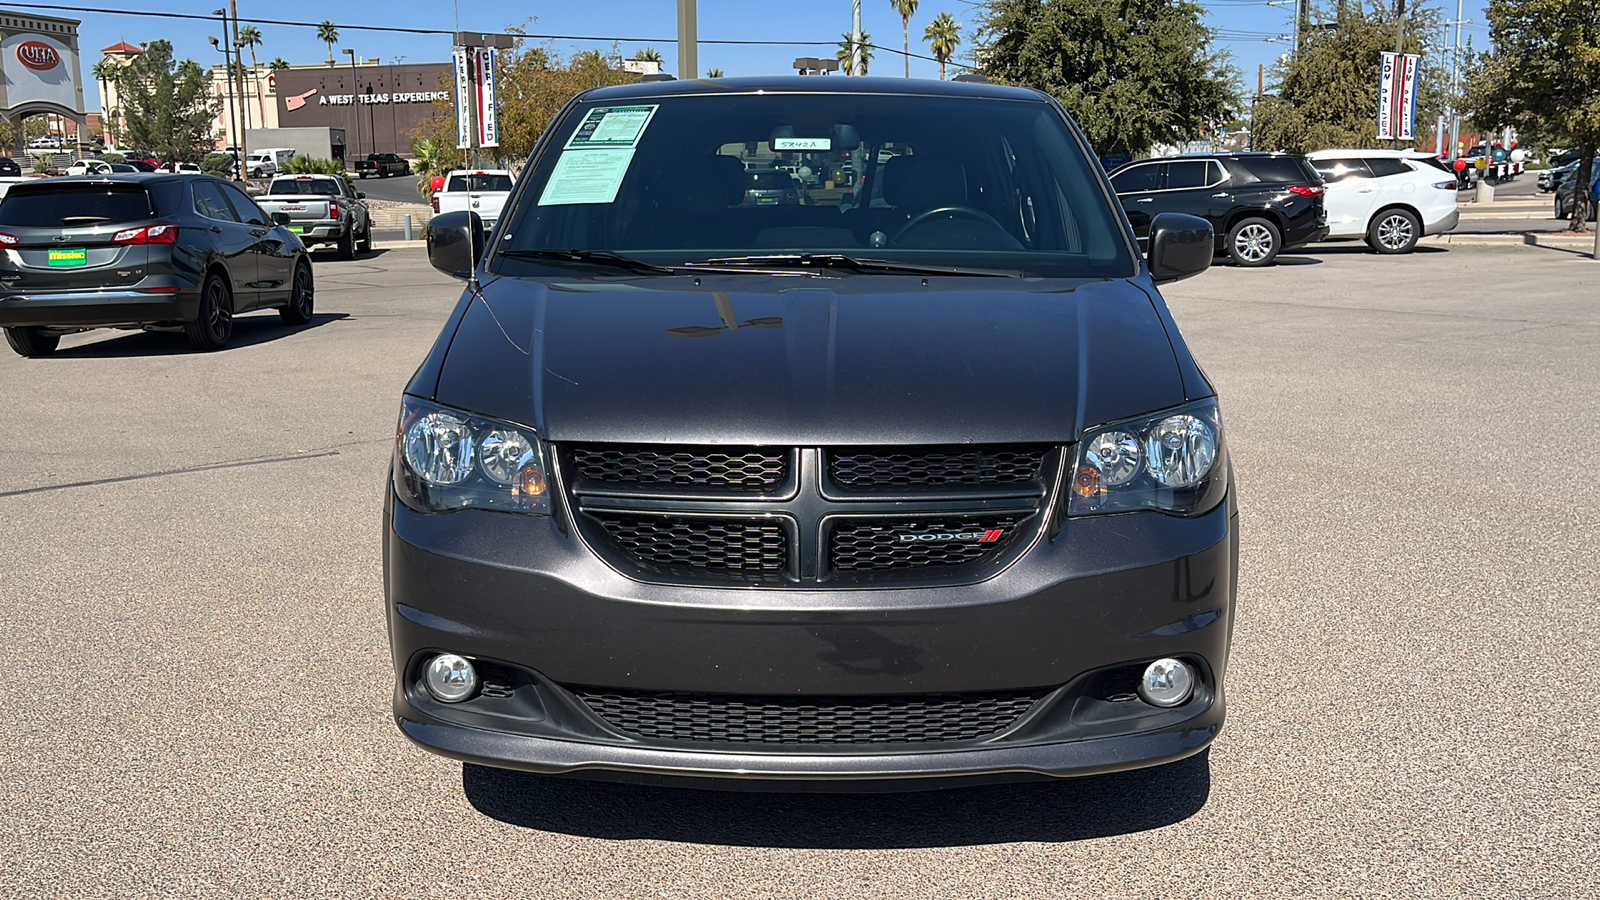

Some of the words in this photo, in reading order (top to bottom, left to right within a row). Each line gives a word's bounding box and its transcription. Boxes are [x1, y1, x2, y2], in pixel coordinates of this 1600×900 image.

[319, 95, 328, 104] A
[329, 94, 354, 104] WEST
[358, 93, 390, 104] TEXAS
[393, 91, 450, 104] EXPERIENCE
[482, 52, 493, 141] CERTIFIED
[899, 532, 987, 542] DODGE
